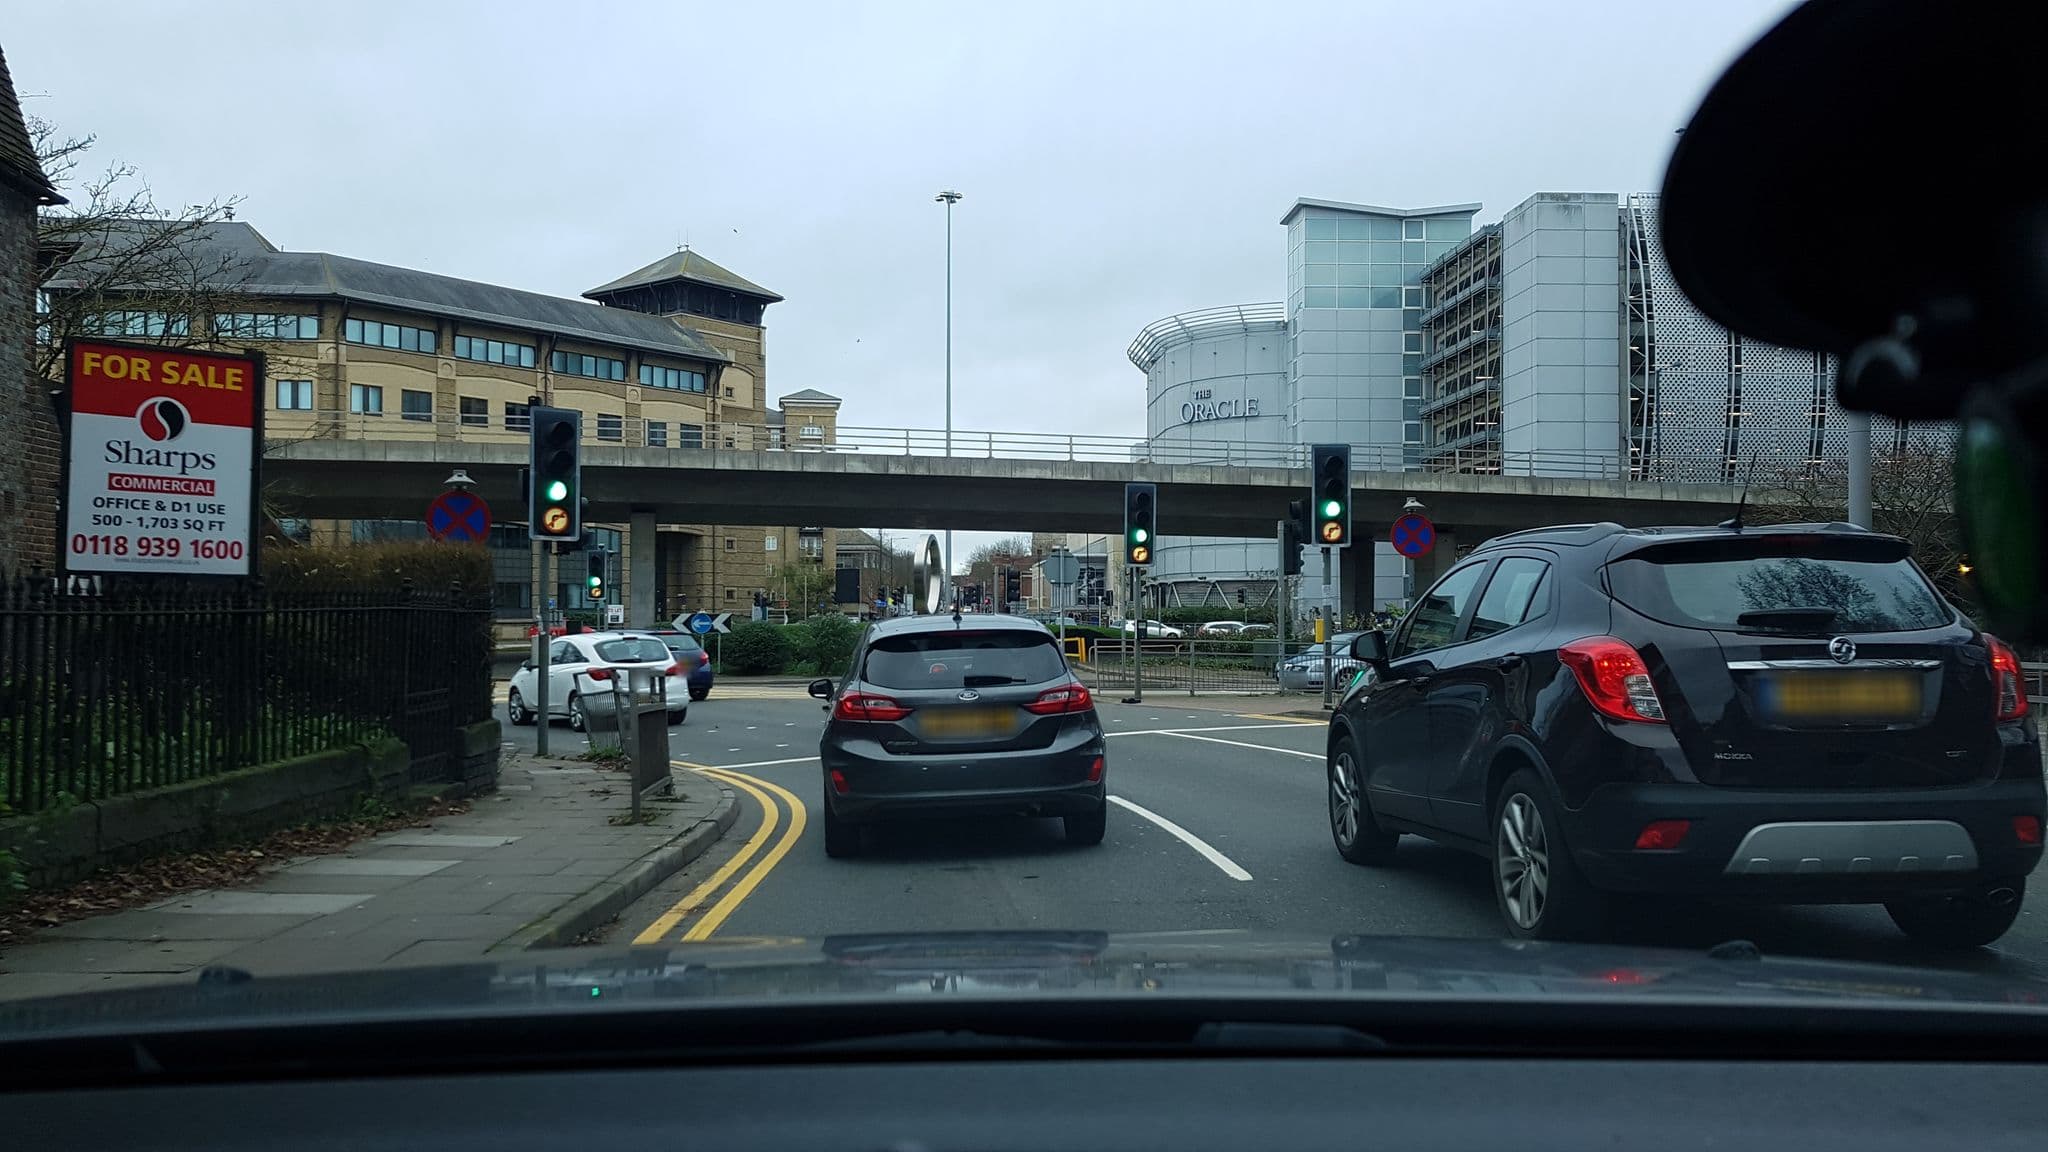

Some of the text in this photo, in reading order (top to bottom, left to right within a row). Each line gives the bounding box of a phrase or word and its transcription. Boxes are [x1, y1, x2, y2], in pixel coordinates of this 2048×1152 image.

[82, 352, 244, 391] FOR SALE
[1193, 388, 1212, 400] THE
[1180, 397, 1260, 423] ORACLE
[104, 439, 216, 475] Sharps
[111, 476, 213, 494] COMMERCIAL
[93, 496, 226, 515] OFFICE & D1 USE
[92, 514, 122, 526] 500
[137, 516, 178, 529] 1,703
[183, 519, 204, 532] SQ
[208, 520, 226, 532] FT
[72, 533, 243, 560] 0118 939 1600
